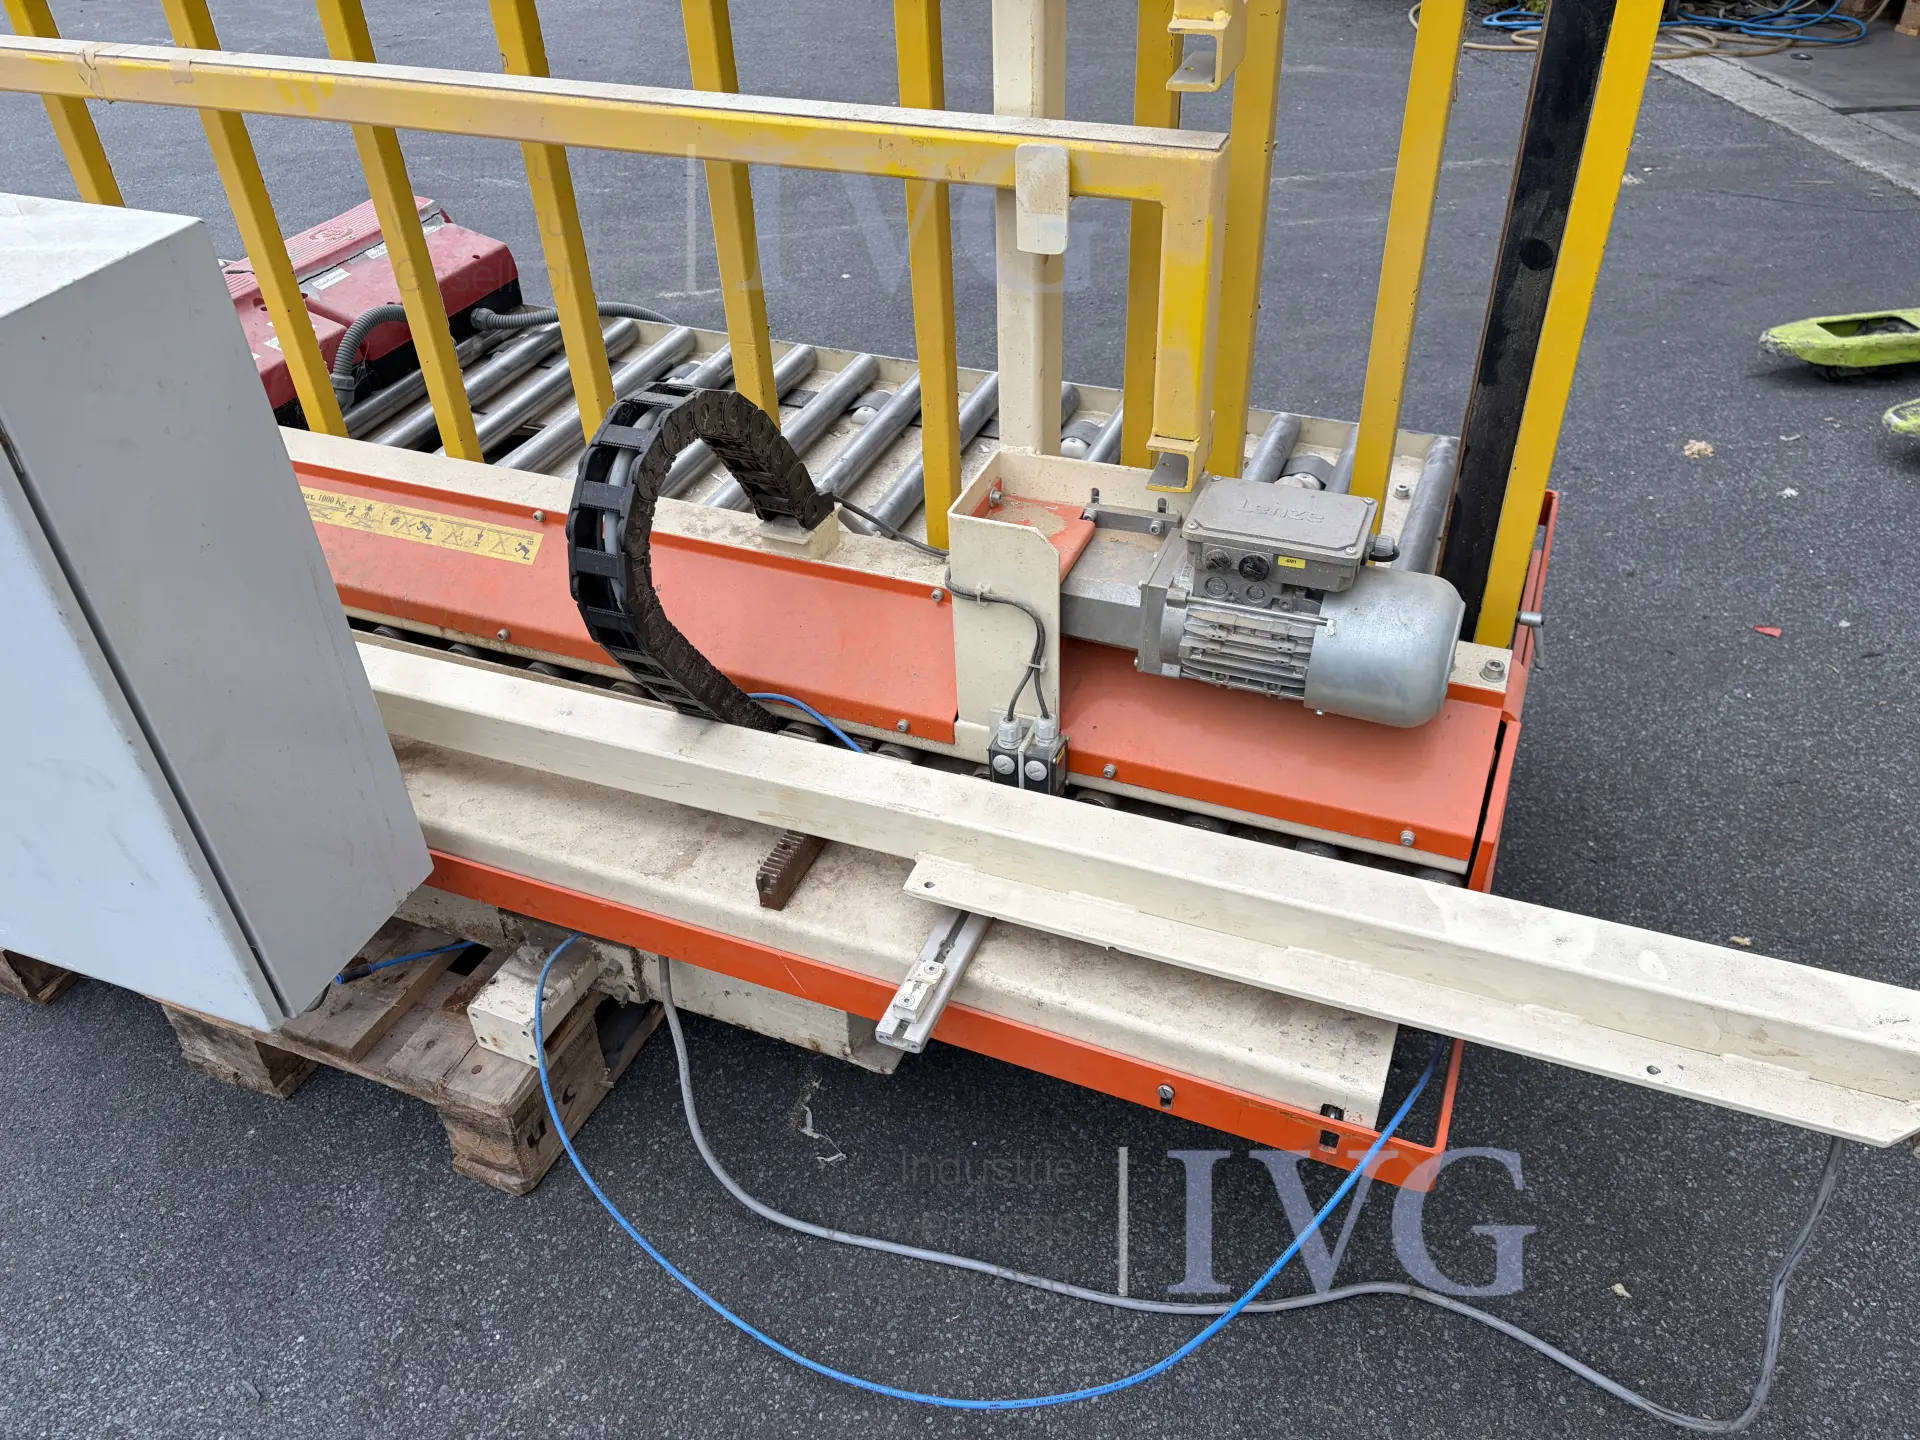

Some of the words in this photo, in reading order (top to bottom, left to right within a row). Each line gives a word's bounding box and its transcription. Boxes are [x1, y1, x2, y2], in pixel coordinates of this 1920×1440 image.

[318, 494, 335, 504] 1000
[335, 497, 347, 508] Kg
[1237, 498, 1325, 523] Lenze
